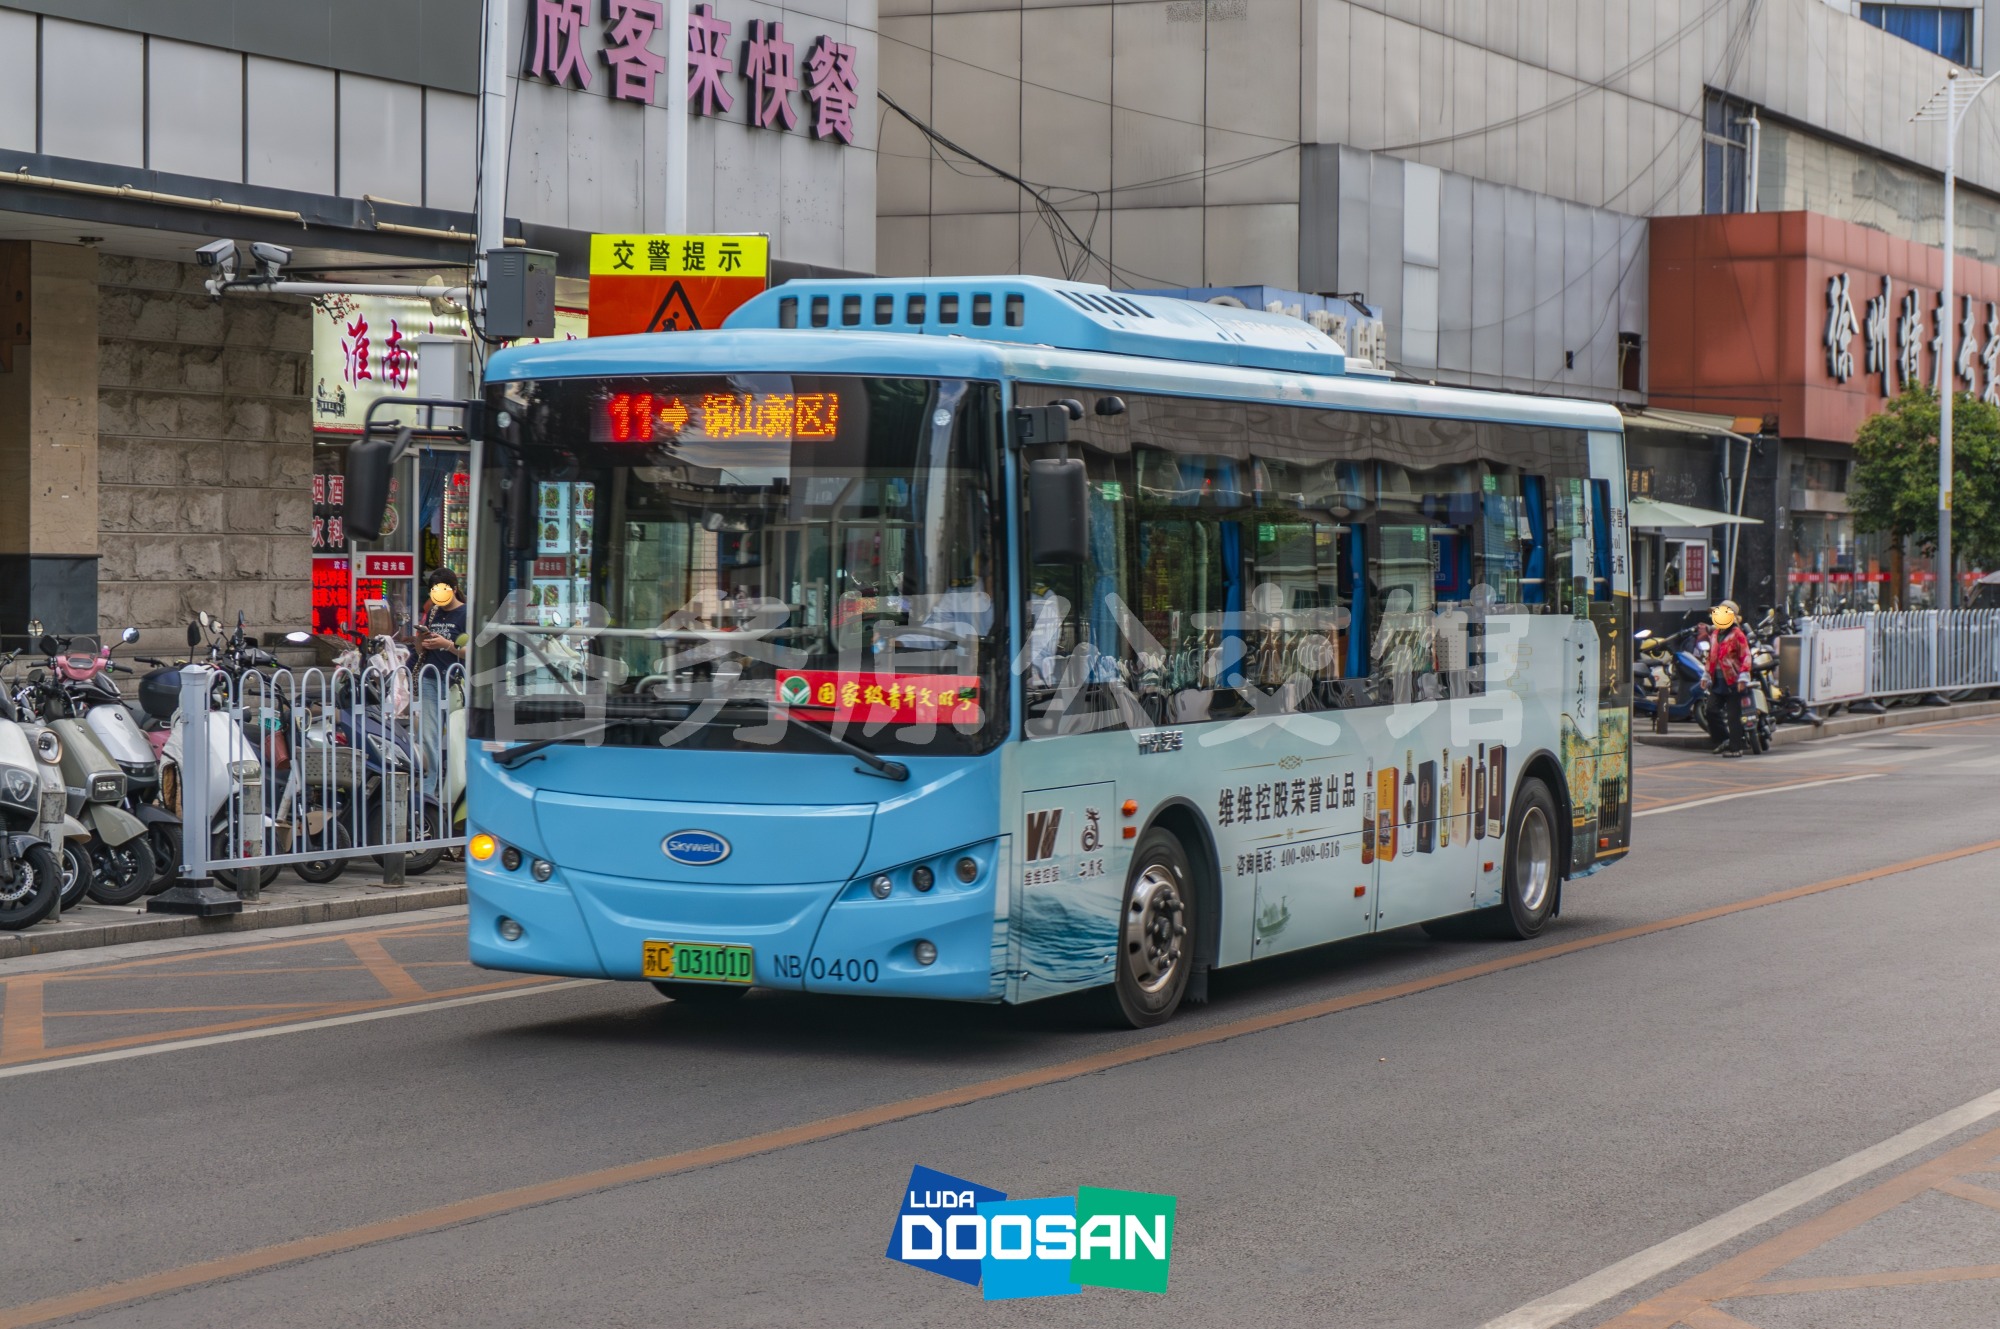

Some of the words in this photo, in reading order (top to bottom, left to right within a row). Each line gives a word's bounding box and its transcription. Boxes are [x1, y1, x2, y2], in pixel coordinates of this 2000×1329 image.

[524, 0, 859, 145] 欣客来快餐
[612, 240, 742, 272] 交警提示
[341, 313, 434, 391] 淮南
[608, 393, 653, 440] 11
[373, 561, 405, 571] 欢迎光临
[1218, 771, 1356, 828] 维维控股荣誉出品
[1280, 840, 1340, 867] 400-998-0516
